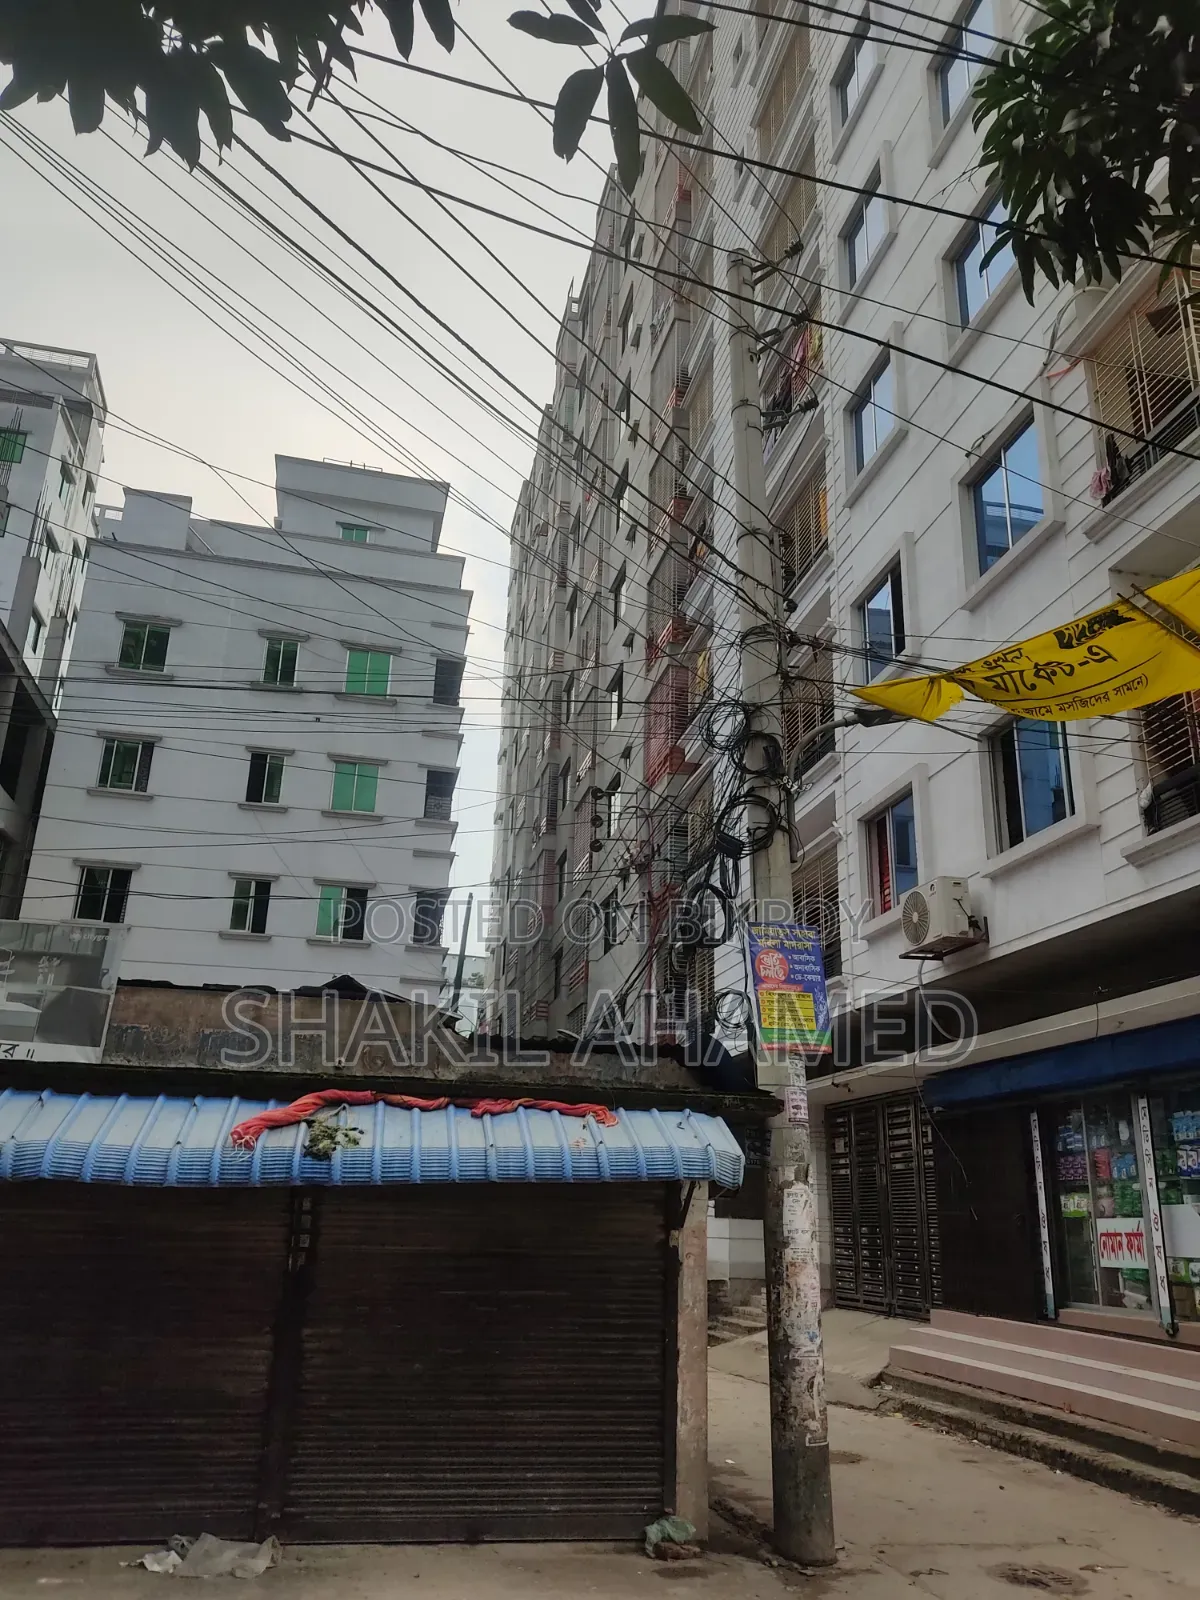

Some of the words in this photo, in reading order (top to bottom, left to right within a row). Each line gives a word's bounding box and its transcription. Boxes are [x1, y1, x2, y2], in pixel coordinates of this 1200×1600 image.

[1056, 690, 1110, 712] মসজিদের
[1099, 1228, 1125, 1261] নোমান
[1124, 1220, 1146, 1263] ফার্মা
